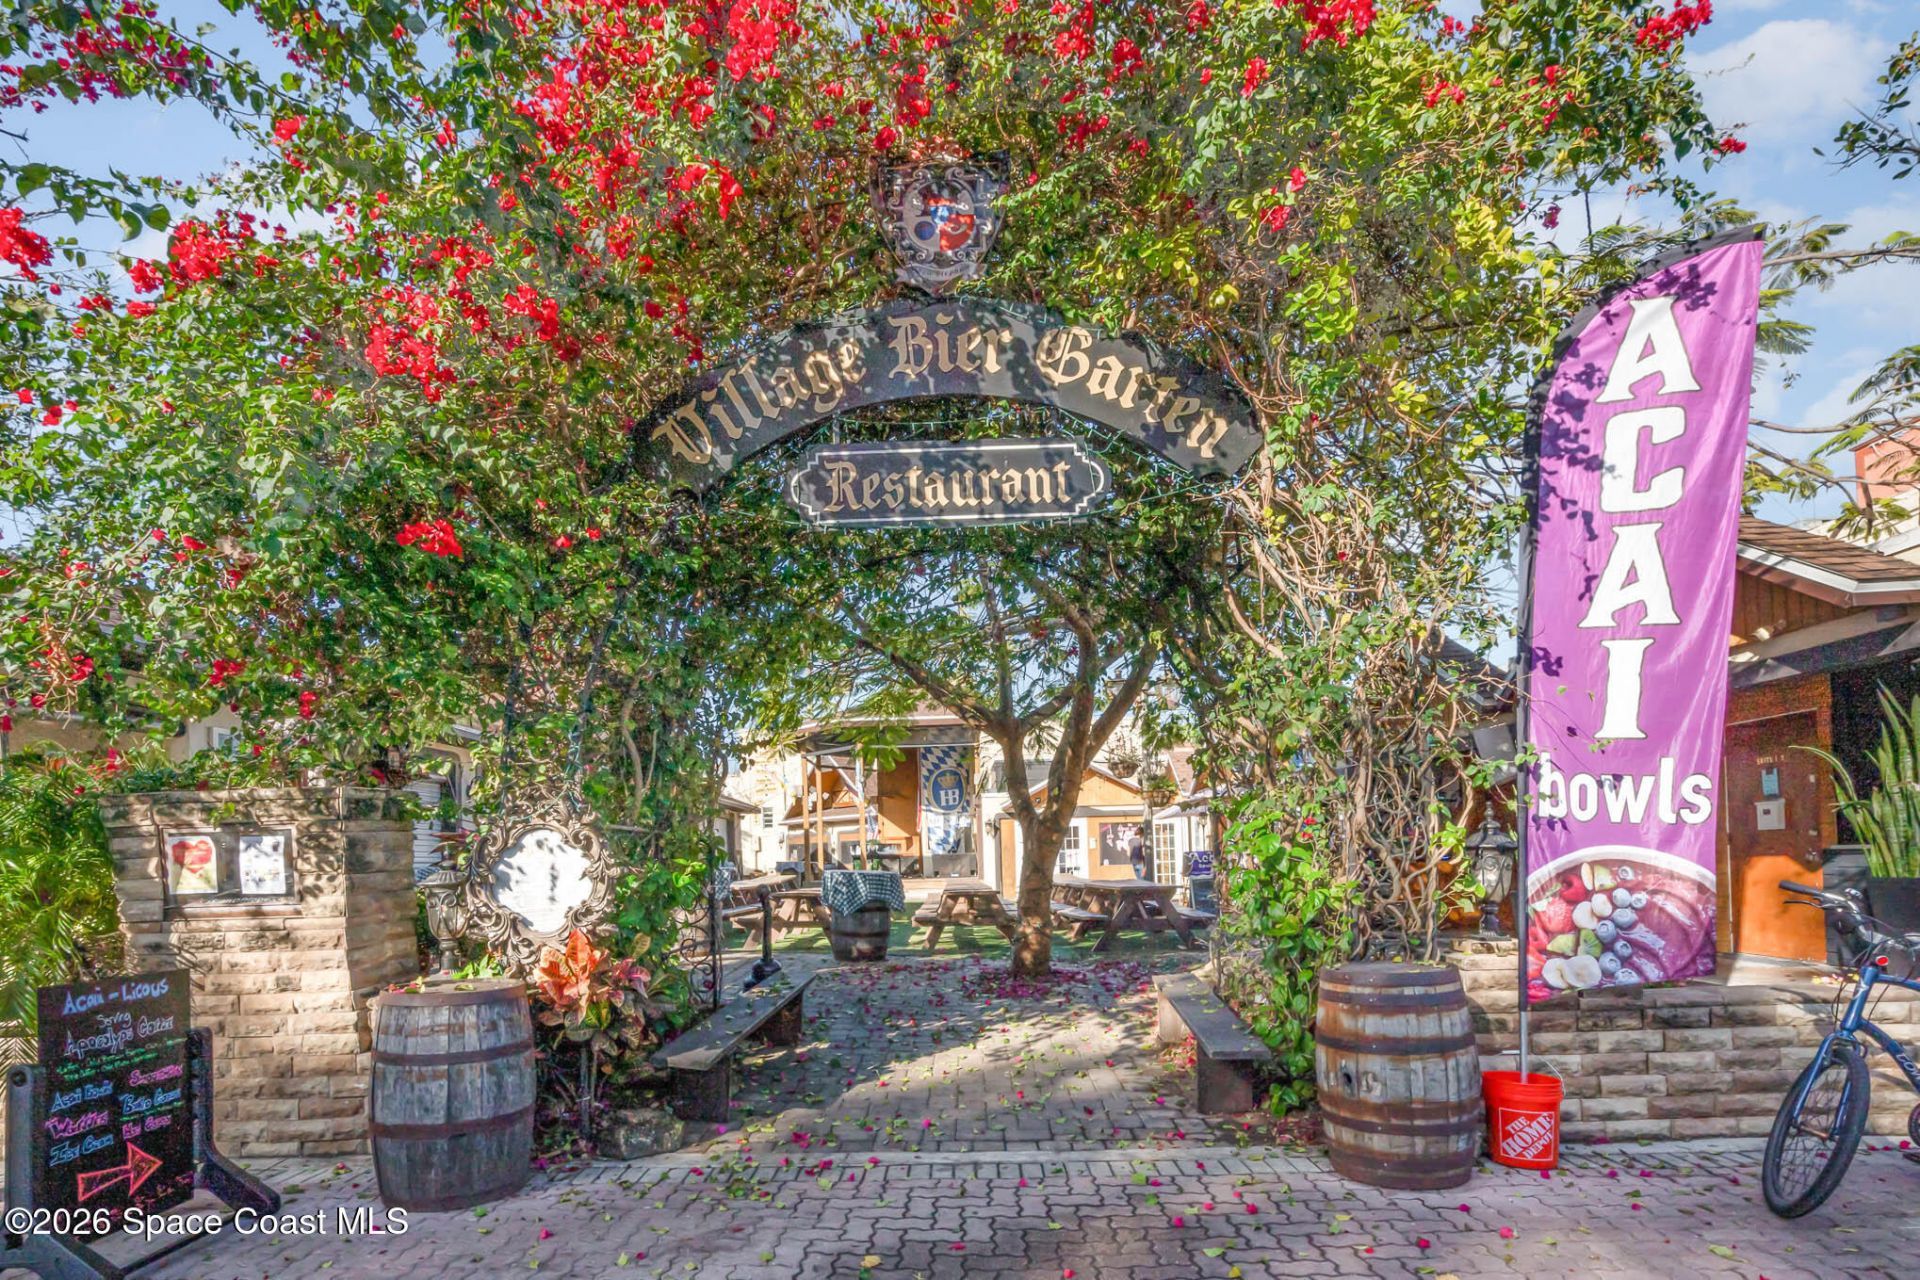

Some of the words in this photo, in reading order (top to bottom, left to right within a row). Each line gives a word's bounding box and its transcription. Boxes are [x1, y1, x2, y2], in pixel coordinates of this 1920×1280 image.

[651, 336, 867, 464] Village
[887, 312, 1015, 379] Bier
[1034, 326, 1231, 459] Garten
[823, 459, 1073, 512] Restaurant
[1578, 296, 1701, 740] ACAI
[939, 788, 960, 806] HB
[1538, 752, 1714, 825] bowls
[62, 987, 104, 1016] Acai
[1502, 1112, 1554, 1157] HOME
[1505, 1116, 1530, 1134] THE
[1522, 1131, 1553, 1159] DEPOT
